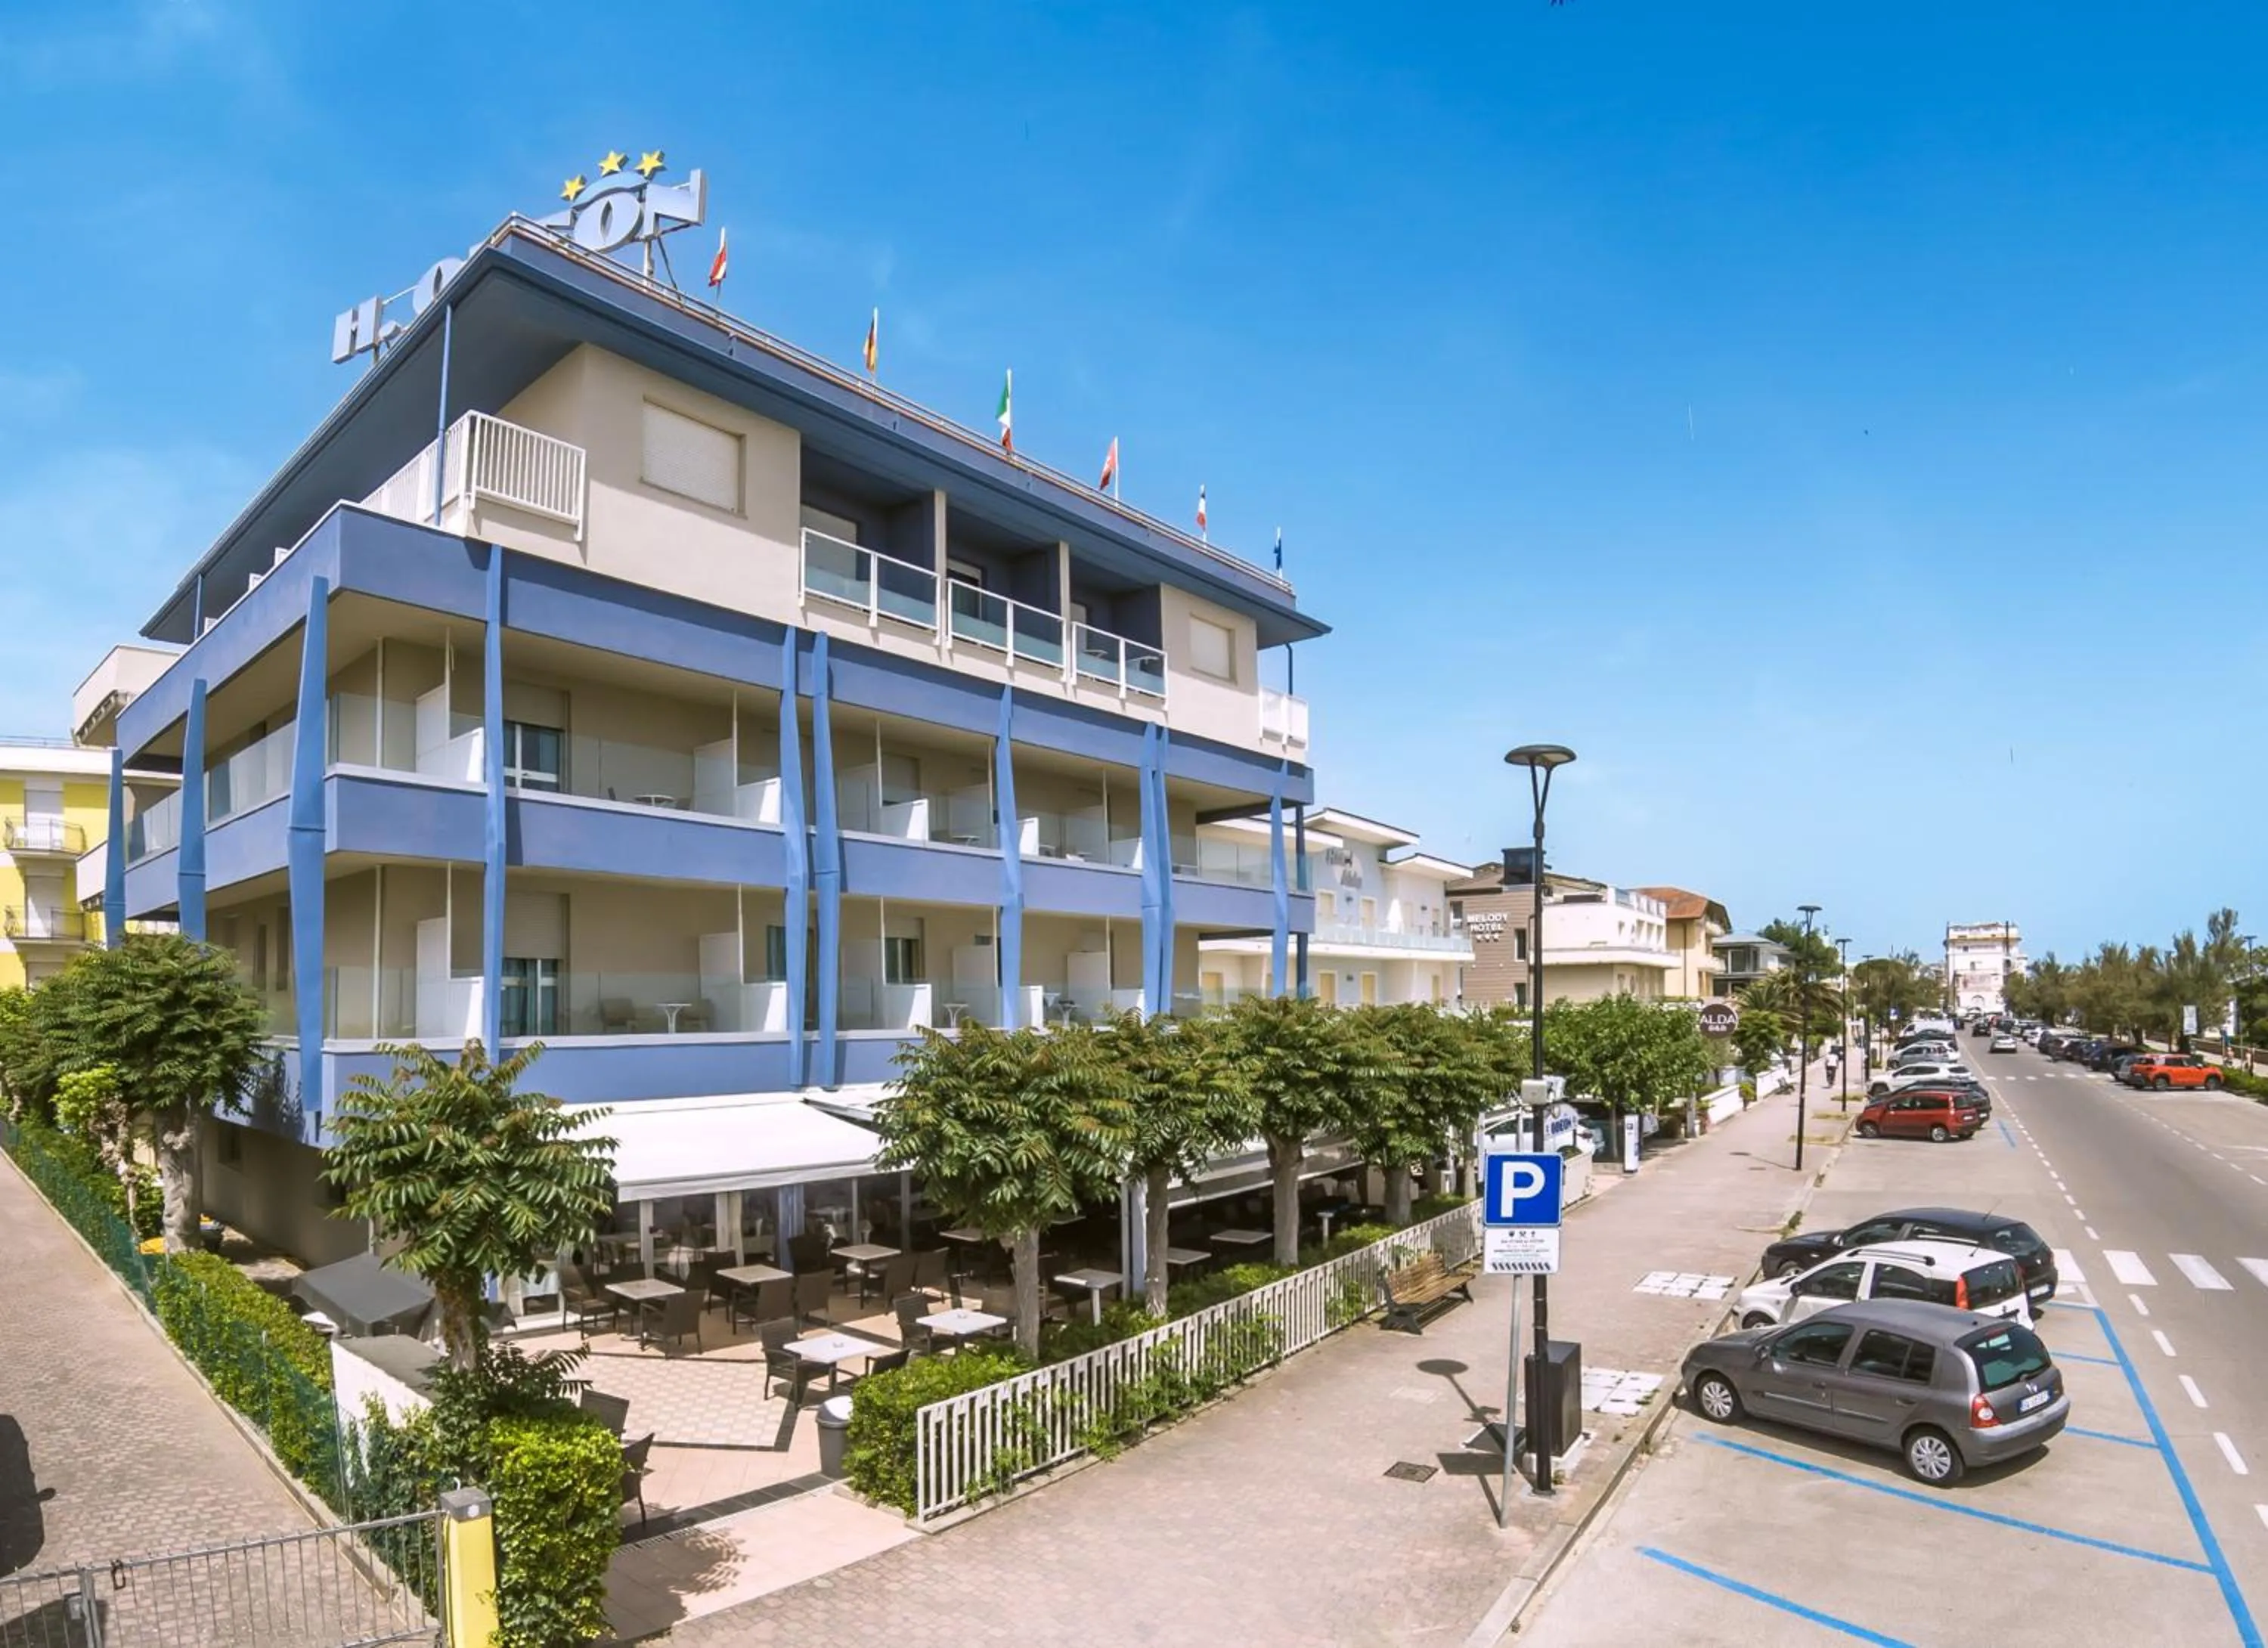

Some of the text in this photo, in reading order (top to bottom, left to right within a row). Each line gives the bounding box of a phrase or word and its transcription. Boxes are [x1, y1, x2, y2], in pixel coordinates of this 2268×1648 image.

[1467, 912, 1508, 922] MELODY
[1470, 923, 1504, 931] HOTEL
[1699, 1014, 1737, 1024] ALDA
[1501, 1161, 1546, 1218] P
